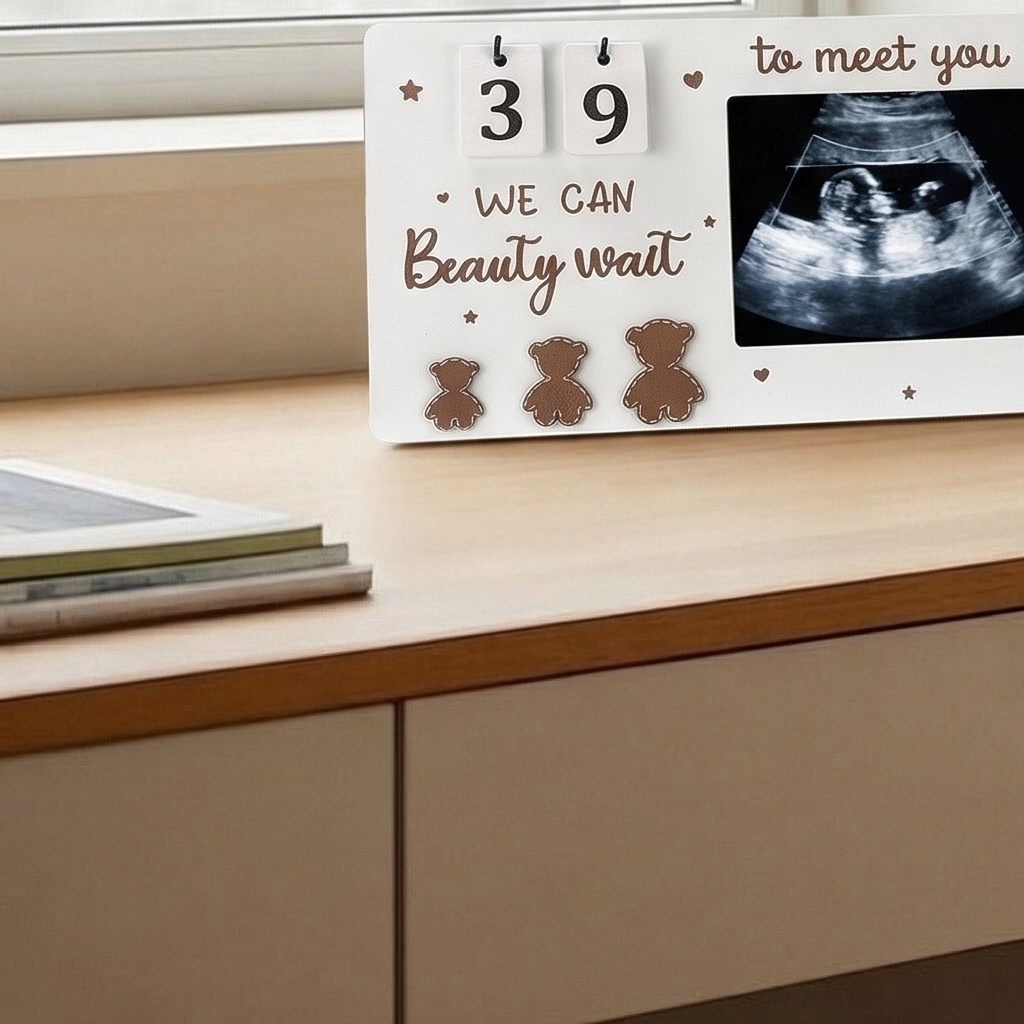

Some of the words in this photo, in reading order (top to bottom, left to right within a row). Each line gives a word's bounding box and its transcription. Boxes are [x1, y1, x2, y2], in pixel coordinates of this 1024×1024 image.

[750, 35, 803, 75] to
[815, 35, 917, 73] meet
[930, 40, 1011, 86] you
[479, 79, 523, 141] 3
[582, 83, 629, 145] 9
[474, 184, 538, 217] WE
[560, 179, 635, 214] CAN
[404, 227, 566, 316] Beauty
[574, 230, 692, 279] wait
